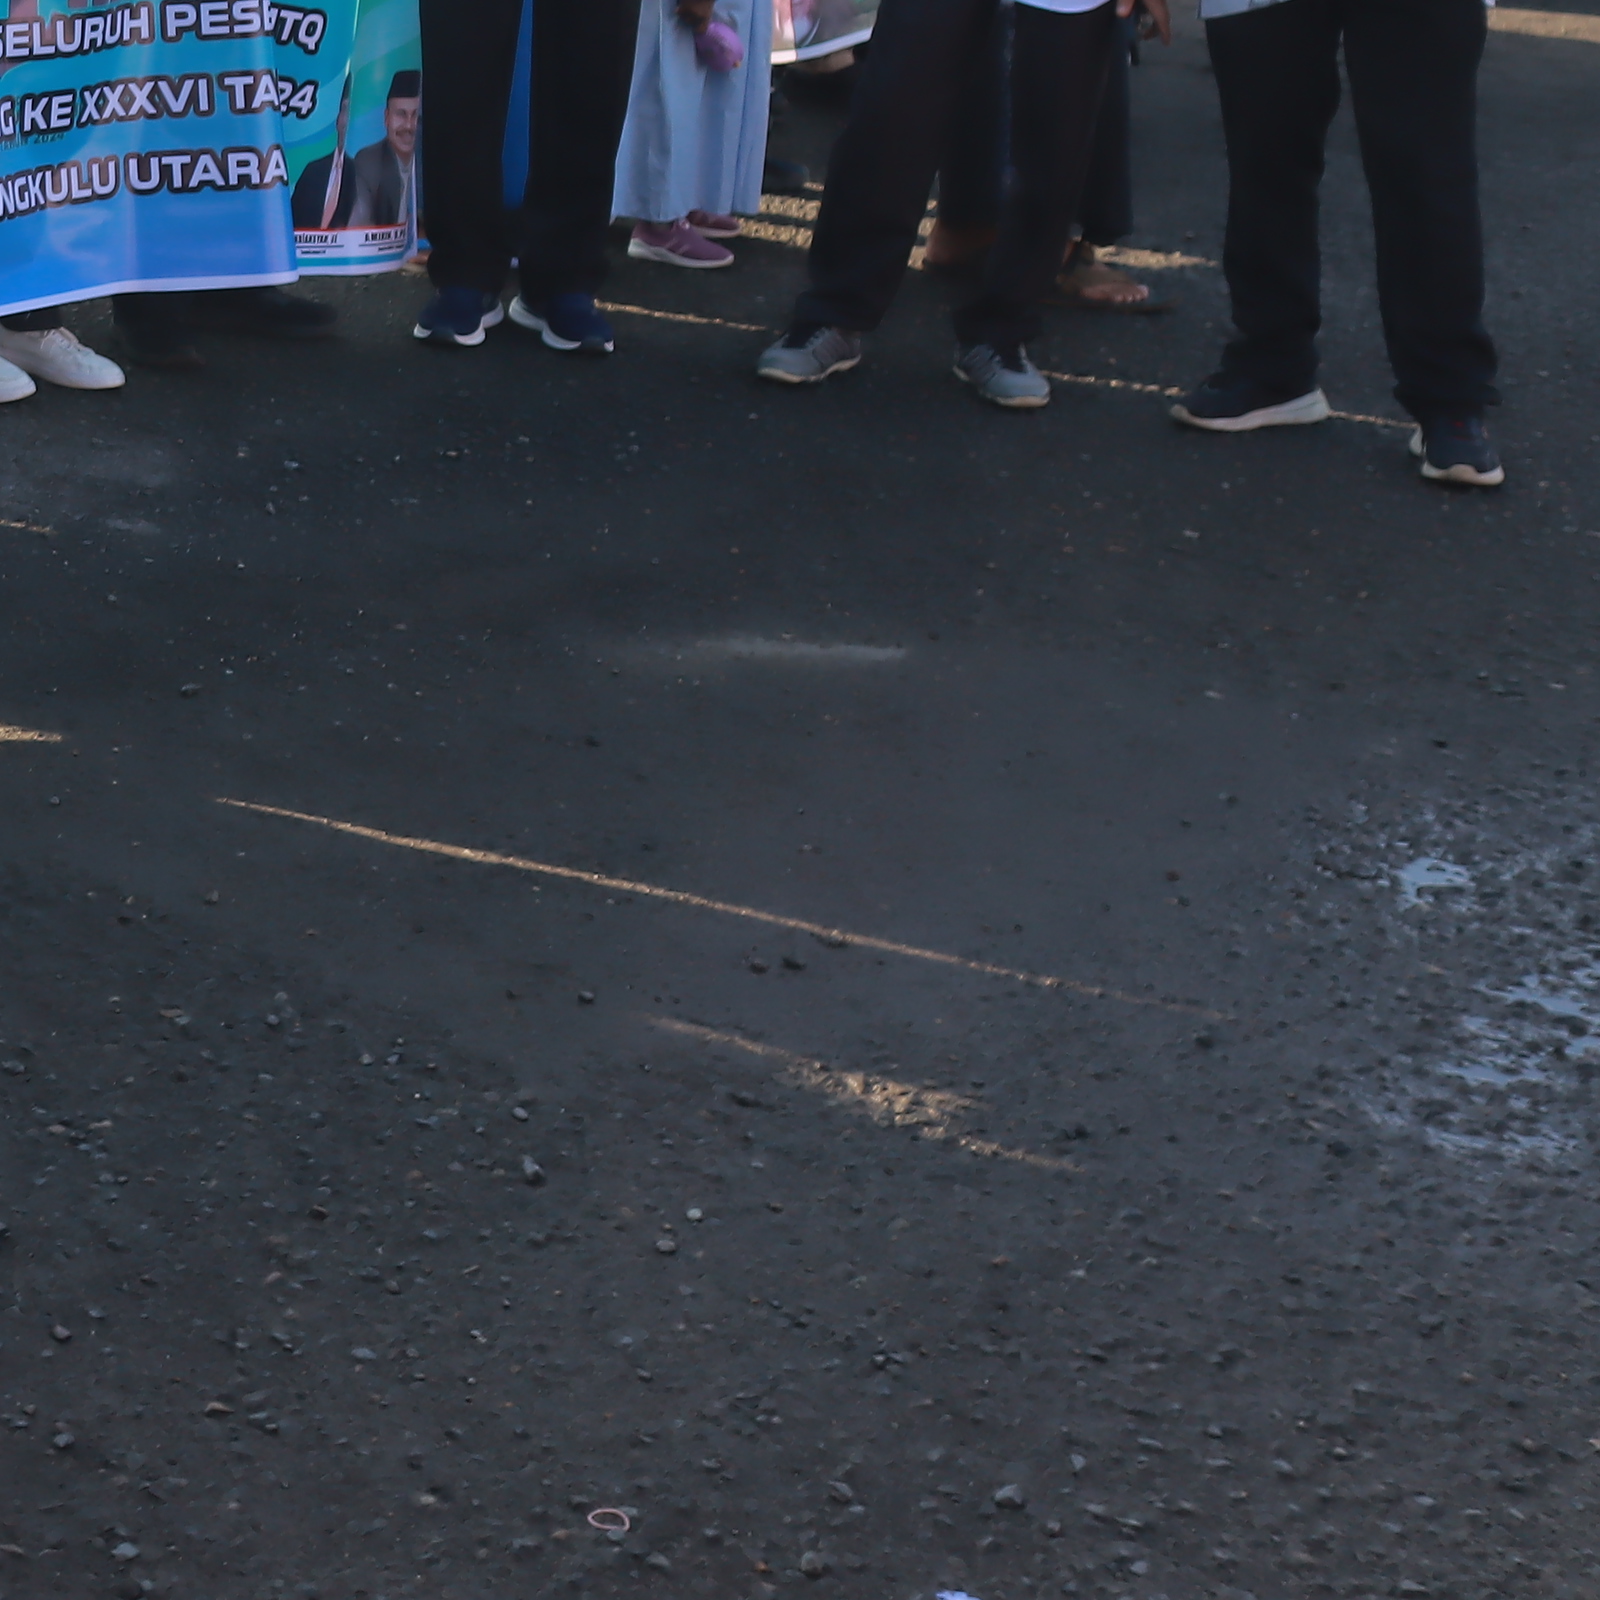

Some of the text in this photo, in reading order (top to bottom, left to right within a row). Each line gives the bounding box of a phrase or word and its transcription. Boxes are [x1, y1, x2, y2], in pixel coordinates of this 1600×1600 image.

[23, 94, 74, 132] KE
[80, 78, 210, 124] XXXVI
[127, 146, 289, 191] UTARA
